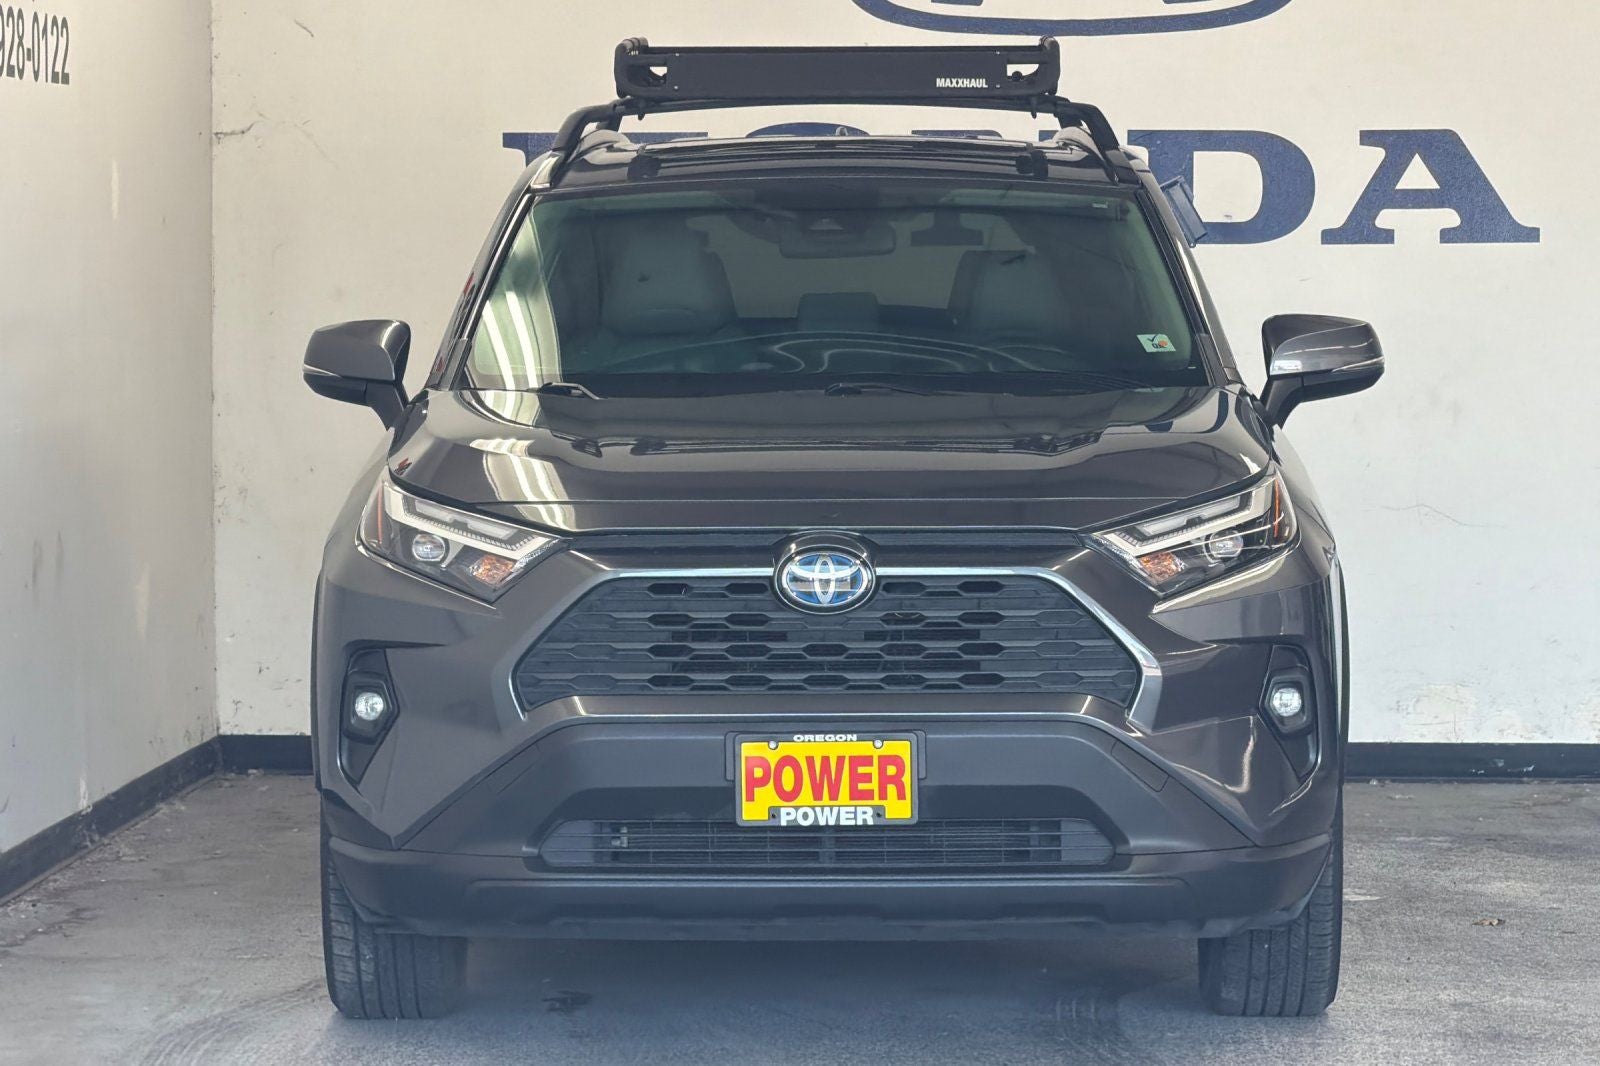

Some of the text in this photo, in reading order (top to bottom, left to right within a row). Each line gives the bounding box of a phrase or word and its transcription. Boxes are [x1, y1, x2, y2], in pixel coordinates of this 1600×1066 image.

[936, 78, 988, 88] MAXXHAUL
[793, 734, 857, 742] OREGON
[745, 755, 906, 802] POWER
[780, 807, 874, 826] POWER
